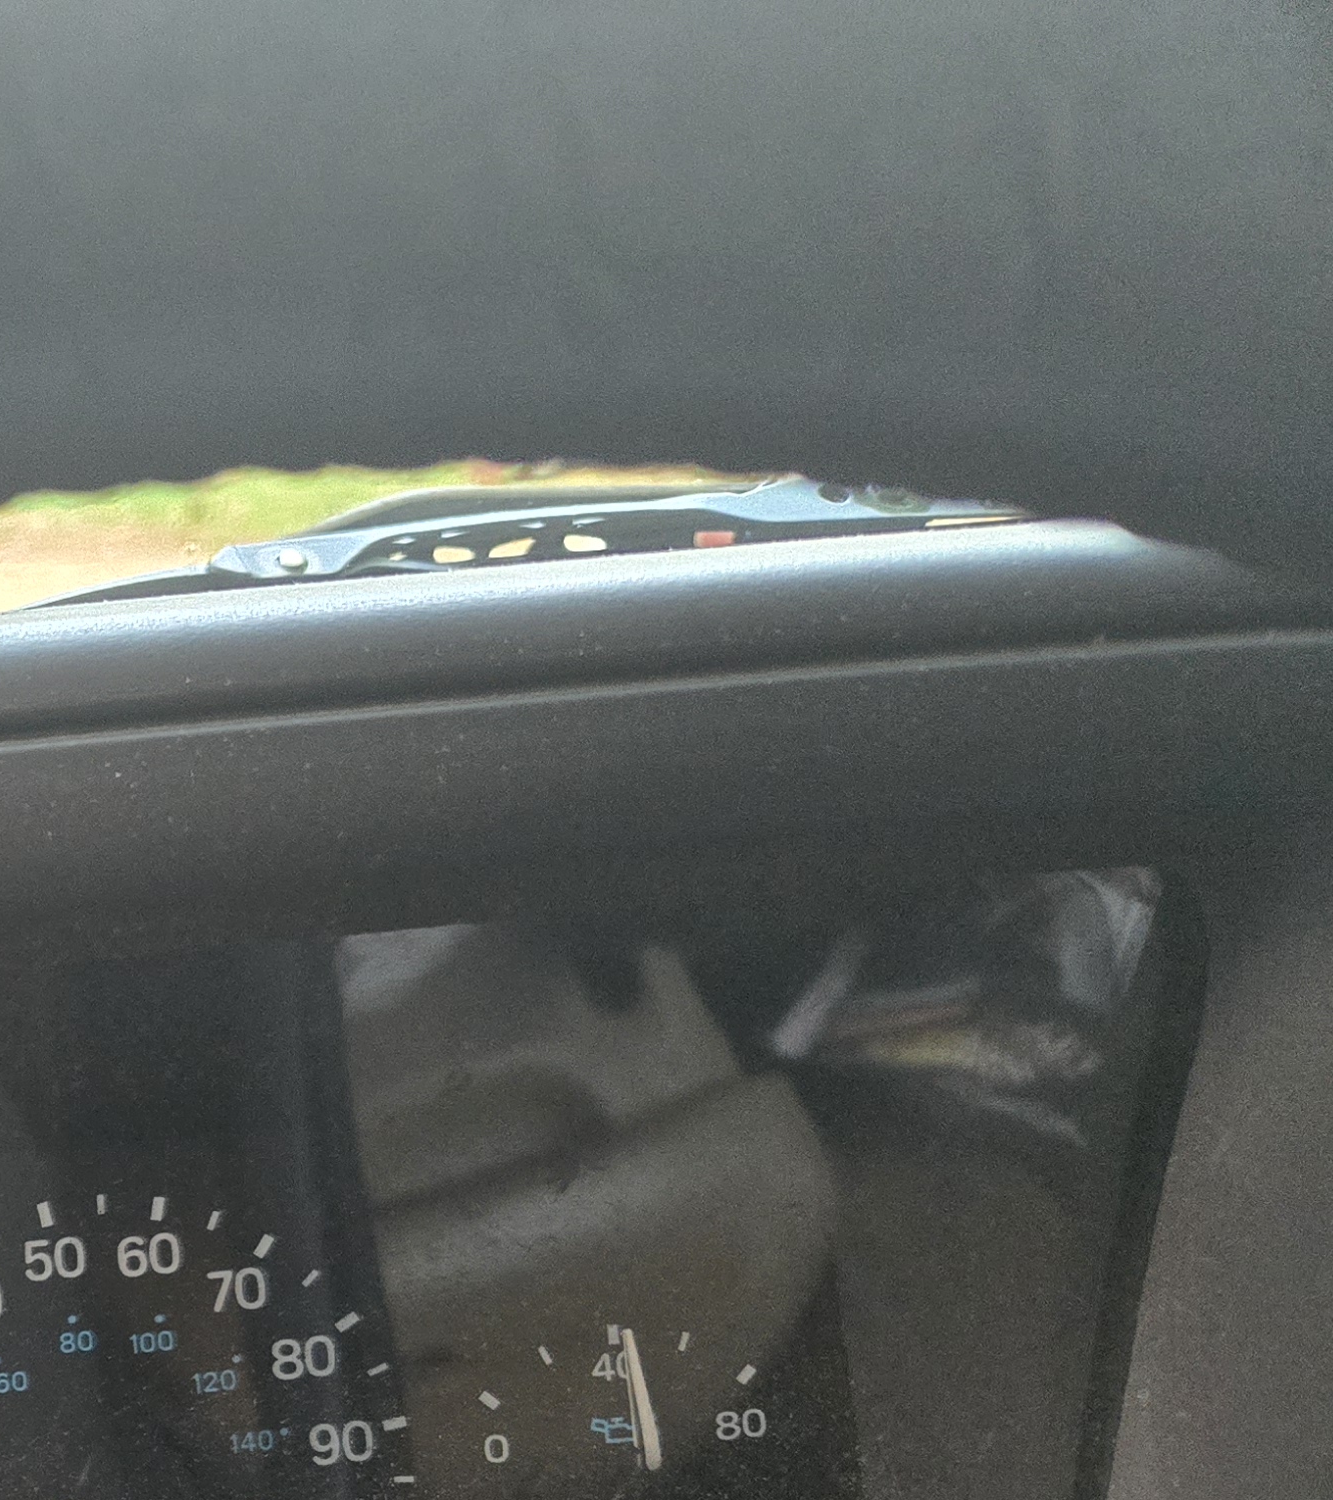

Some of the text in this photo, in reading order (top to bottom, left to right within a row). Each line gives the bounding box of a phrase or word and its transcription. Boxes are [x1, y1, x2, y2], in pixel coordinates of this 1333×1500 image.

[23, 1237, 86, 1280] 50
[117, 1232, 181, 1277] 60
[206, 1267, 267, 1312] 70
[59, 1331, 94, 1353] 80
[130, 1330, 175, 1353] 100
[271, 1335, 335, 1380] 80
[192, 1370, 236, 1393] 120
[715, 1409, 766, 1440] 80
[230, 1430, 273, 1453] 140
[309, 1420, 373, 1466] 90
[483, 1434, 509, 1463] 0
